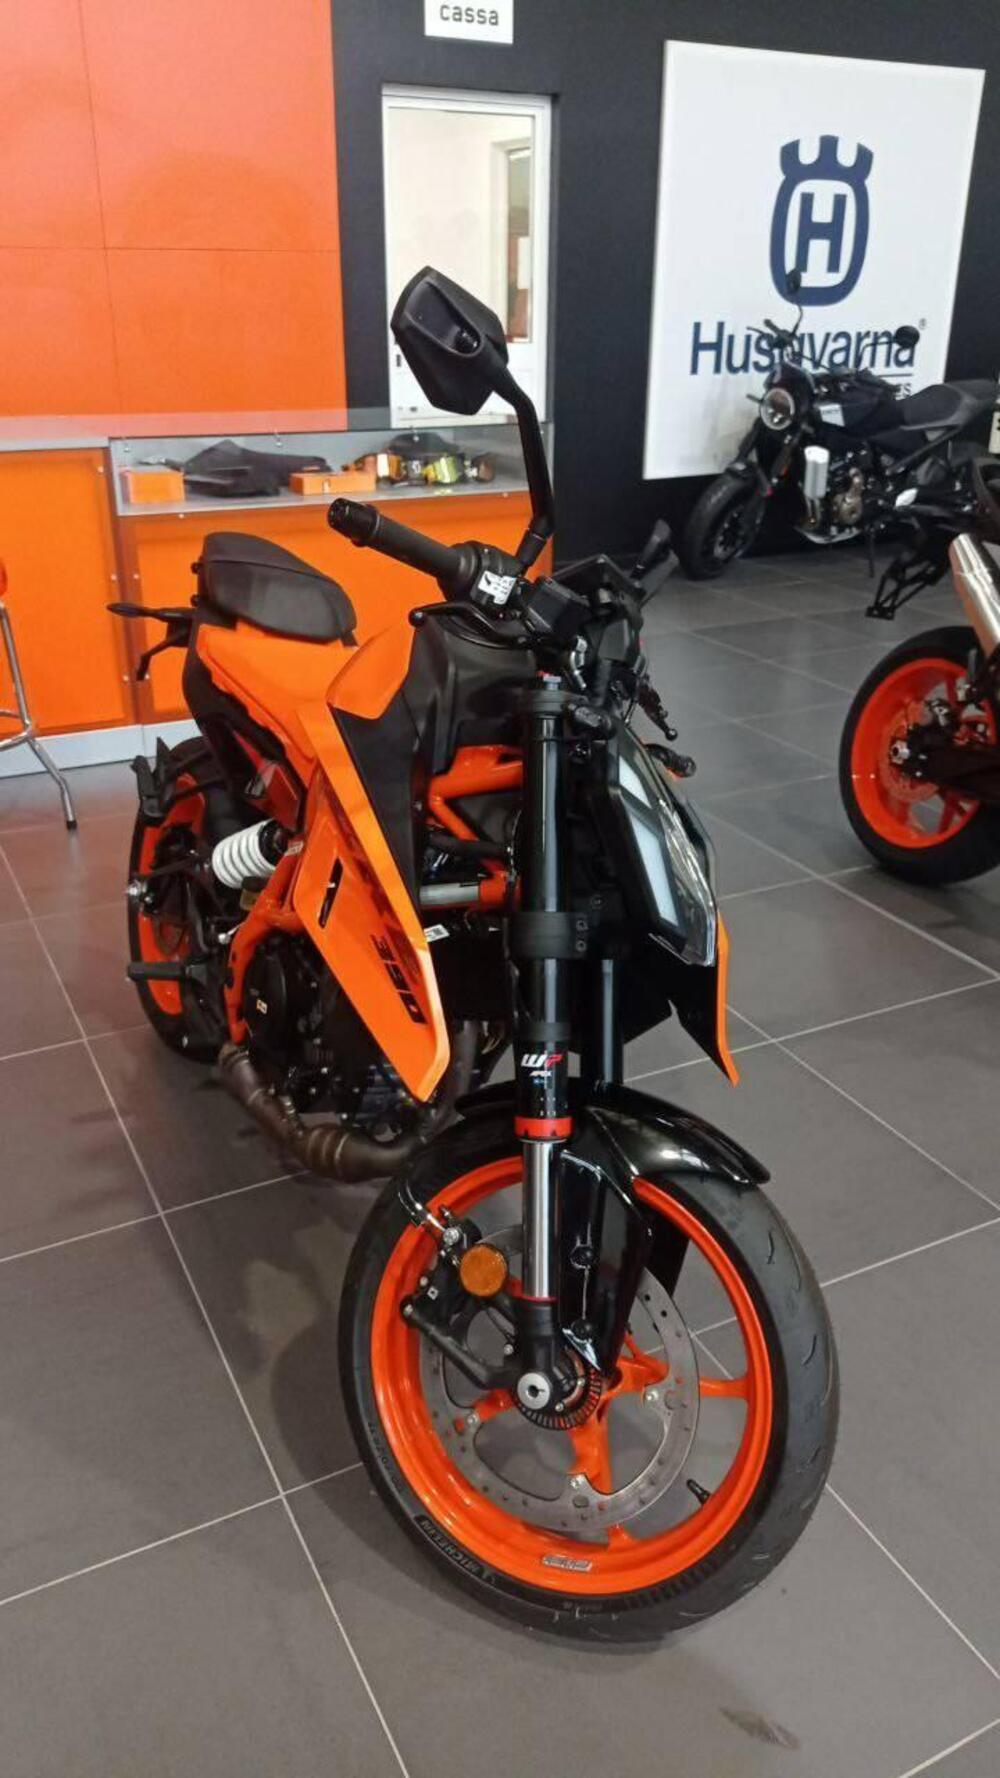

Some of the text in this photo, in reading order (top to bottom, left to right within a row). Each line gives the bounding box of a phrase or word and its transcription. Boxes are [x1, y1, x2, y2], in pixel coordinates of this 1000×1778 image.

[440, 4, 499, 26] cassa
[795, 191, 848, 274] H
[520, 1053, 563, 1069] WP
[420, 1519, 481, 1572] MICHELIN
